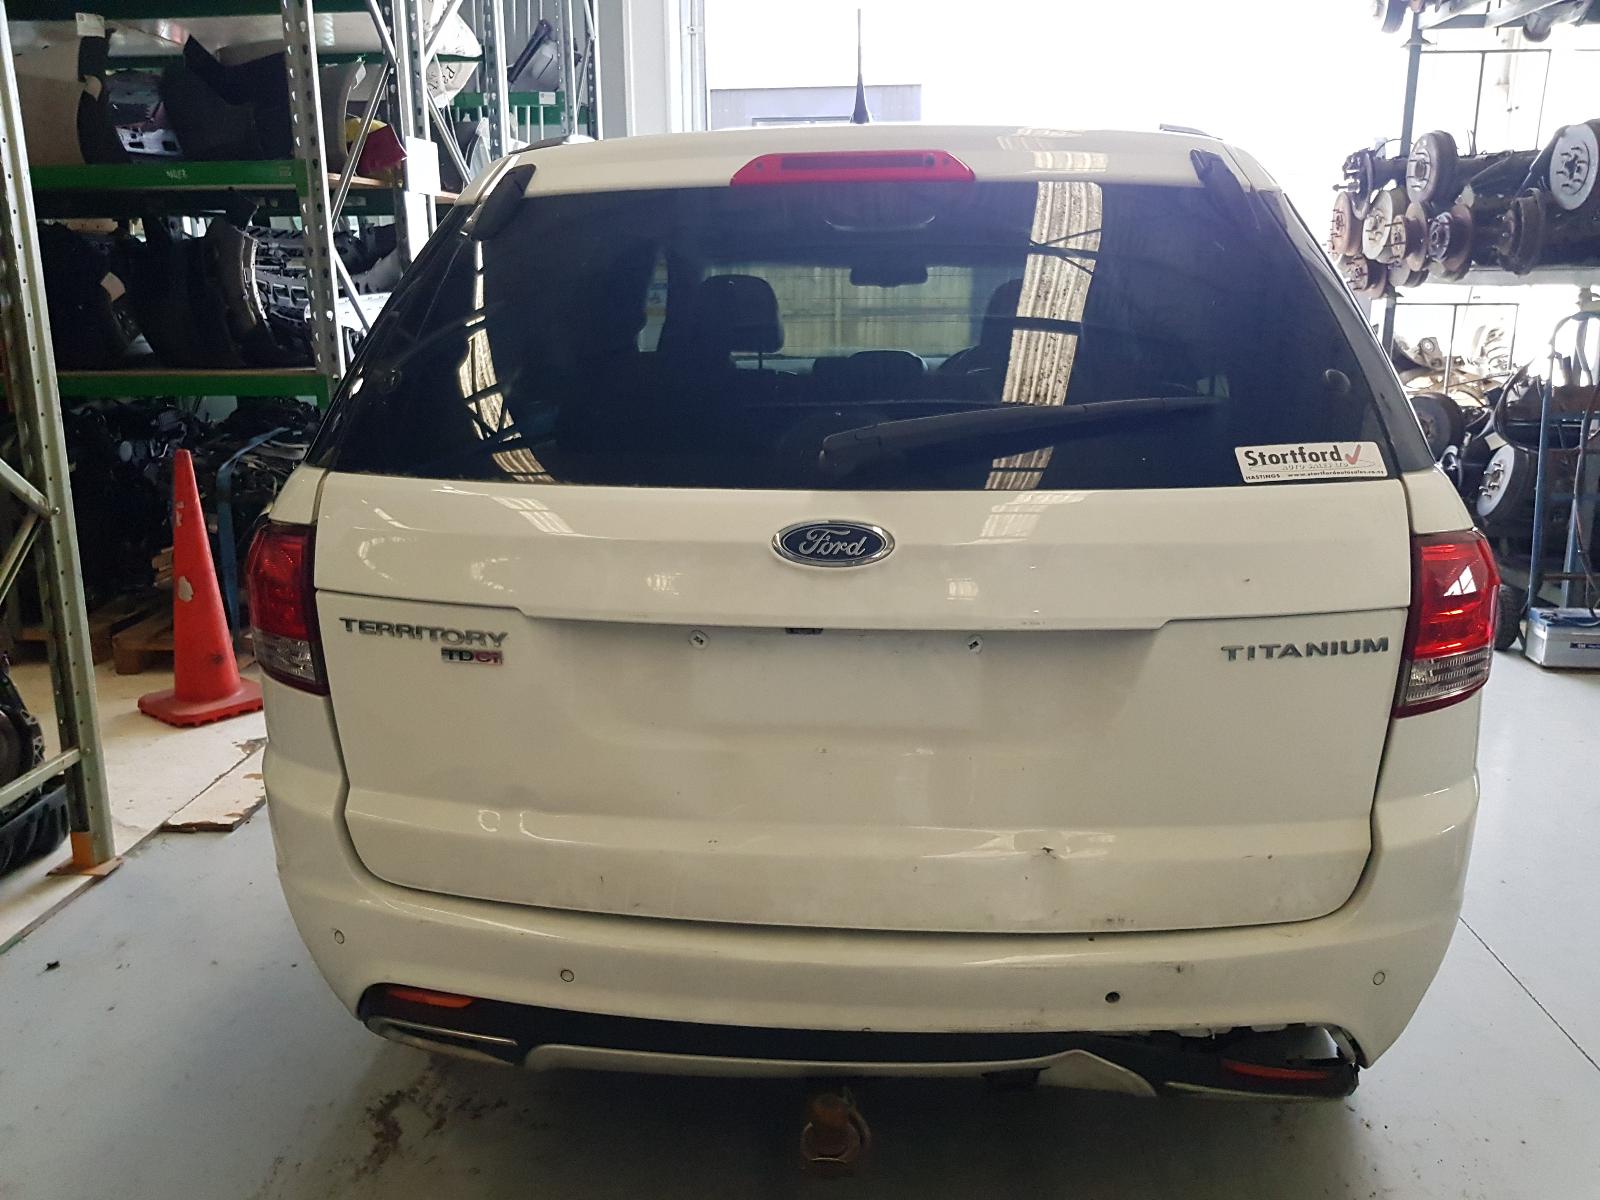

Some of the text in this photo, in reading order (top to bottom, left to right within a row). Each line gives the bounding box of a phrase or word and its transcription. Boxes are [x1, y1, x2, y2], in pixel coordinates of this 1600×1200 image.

[1244, 445, 1342, 466] Stortford
[798, 528, 868, 556] Ford
[339, 617, 508, 648] TERRITORY
[1221, 637, 1389, 661] TITANIUM
